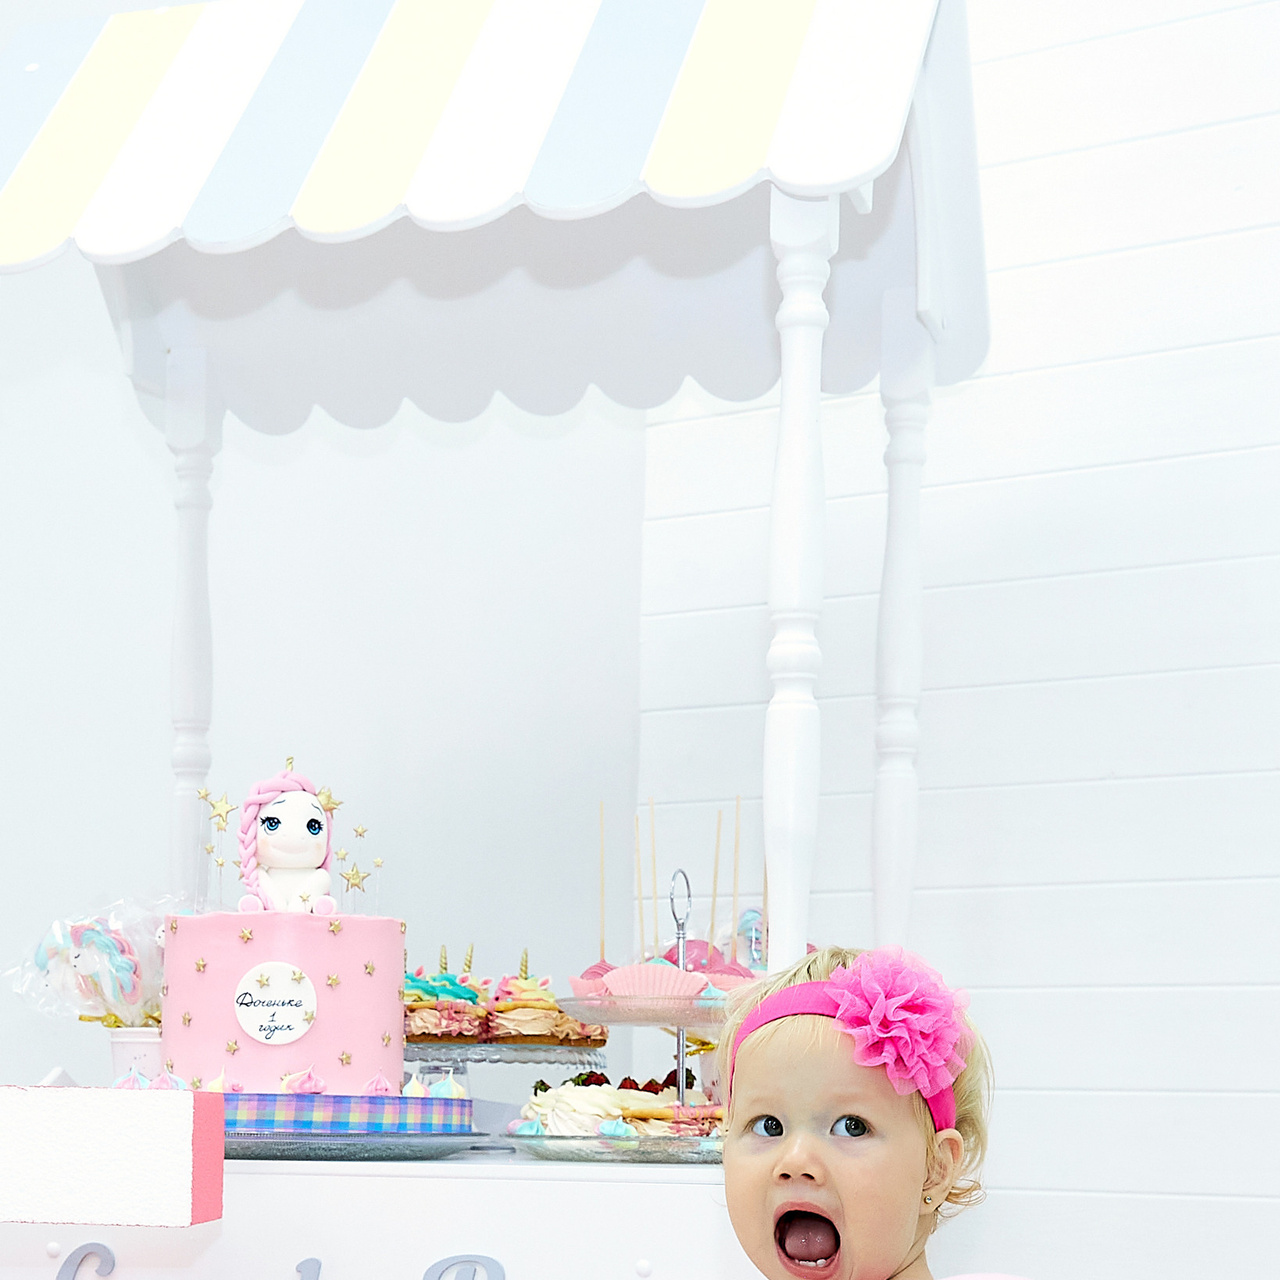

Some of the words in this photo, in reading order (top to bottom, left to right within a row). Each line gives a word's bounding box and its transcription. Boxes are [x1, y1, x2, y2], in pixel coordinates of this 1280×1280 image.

[235, 992, 304, 1008] Доченьке
[268, 1011, 277, 1023] 1
[258, 1024, 295, 1040] годик
